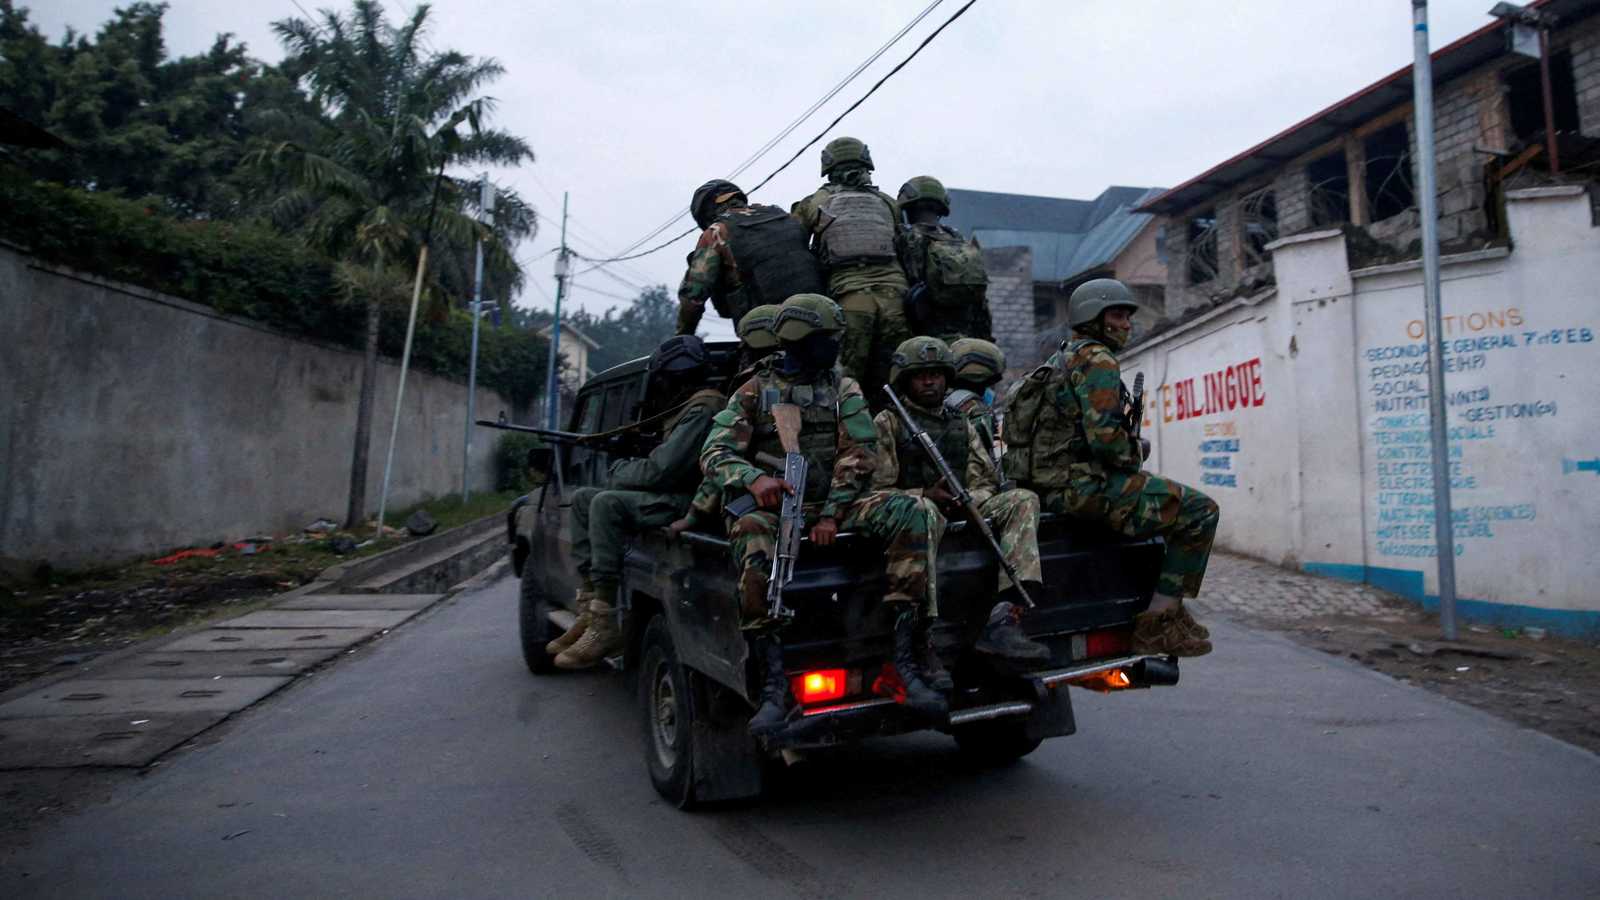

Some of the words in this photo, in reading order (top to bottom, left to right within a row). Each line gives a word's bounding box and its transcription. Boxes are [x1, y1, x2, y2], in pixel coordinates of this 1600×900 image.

[1407, 307, 1524, 339] OTIONS
[1454, 333, 1518, 353] GENERAL
[1176, 357, 1265, 421] BILINGUE
